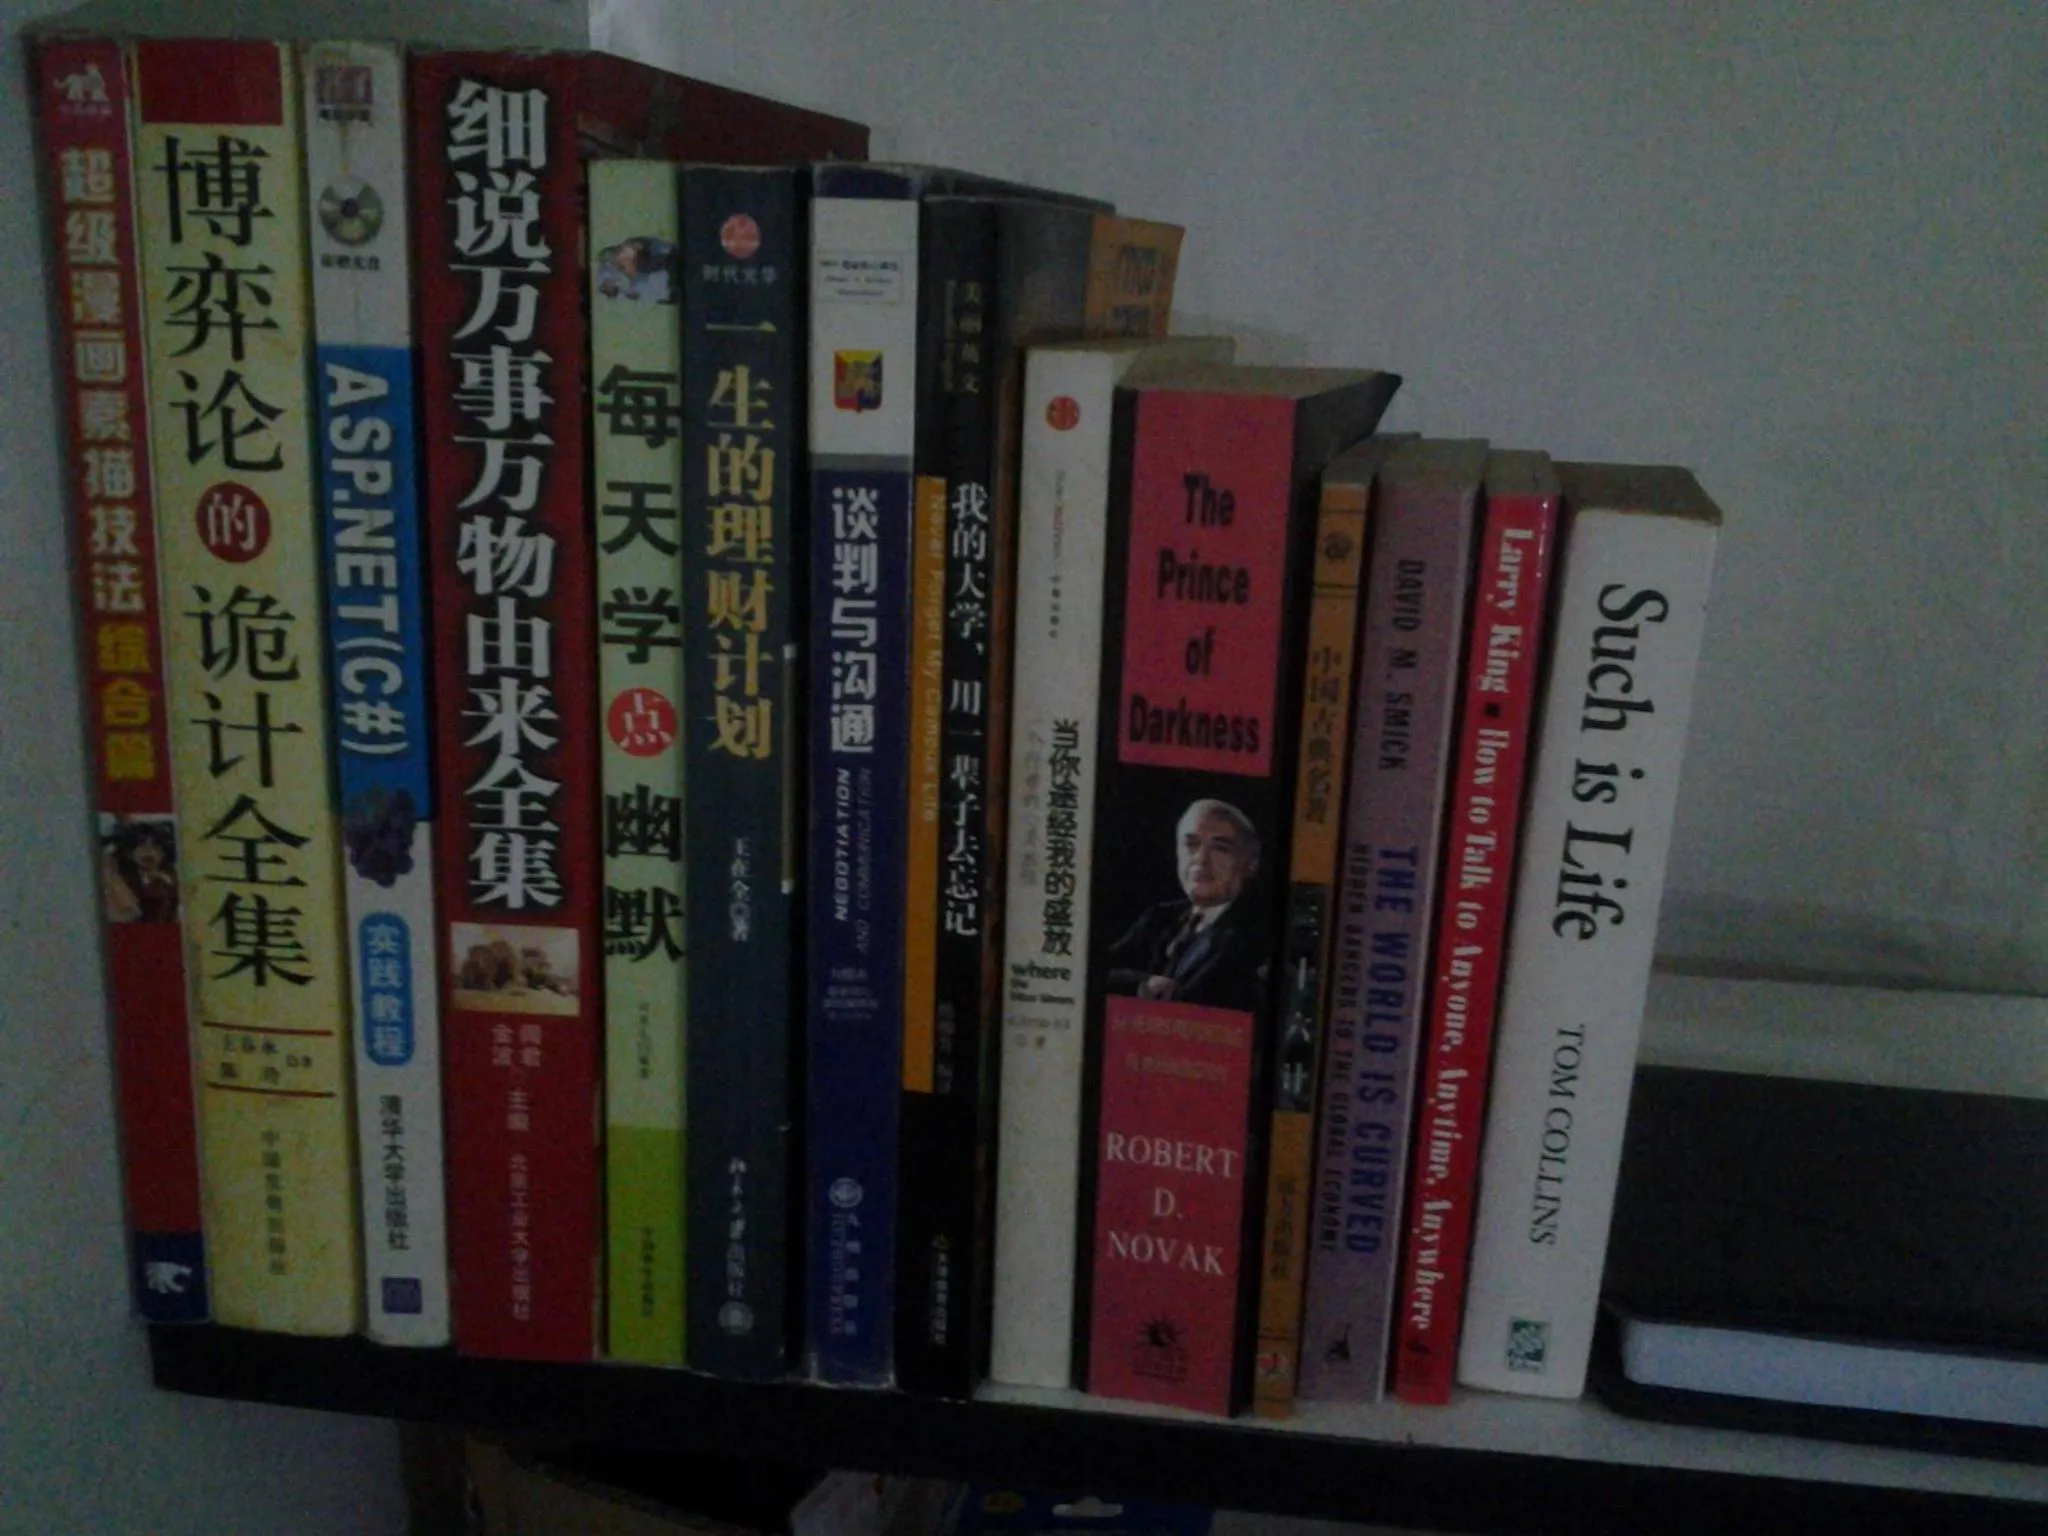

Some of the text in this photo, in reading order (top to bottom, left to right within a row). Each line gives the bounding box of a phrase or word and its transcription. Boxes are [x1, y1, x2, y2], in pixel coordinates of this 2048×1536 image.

[446, 79, 562, 908] 细说万事万物由来全集
[1185, 475, 1234, 525] The
[154, 136, 314, 986] 博弈论的诡计全集
[325, 364, 409, 754] ASP.NET(C#)
[704, 321, 776, 760] 一生的理财计划
[1157, 549, 1249, 605] Prince
[1486, 527, 1534, 611] Larry
[831, 487, 879, 754] 谈判与沟通
[1393, 558, 1427, 634] DAVID
[598, 365, 685, 963] 每天学点幽默
[1184, 630, 1213, 676] of
[1478, 623, 1522, 693] King
[1127, 693, 1261, 755] Darkness
[1378, 692, 1412, 773] SMICK
[1475, 727, 1510, 786] How
[1551, 583, 1669, 942] Such is Life
[1467, 791, 1498, 824] to
[1460, 833, 1498, 889] Talk
[1455, 899, 1484, 931] to
[1440, 944, 1483, 1053] Anyone,
[1346, 848, 1417, 1253] THE WORLD IS CURVED
[1105, 1131, 1238, 1178] ROBERT
[1422, 1068, 1470, 1186] Anytime,
[1528, 1023, 1587, 1246] TOM COLLINS
[1153, 1187, 1184, 1220] D.
[1106, 1230, 1224, 1276] NOVAK
[1410, 1198, 1453, 1331] Anywhere
